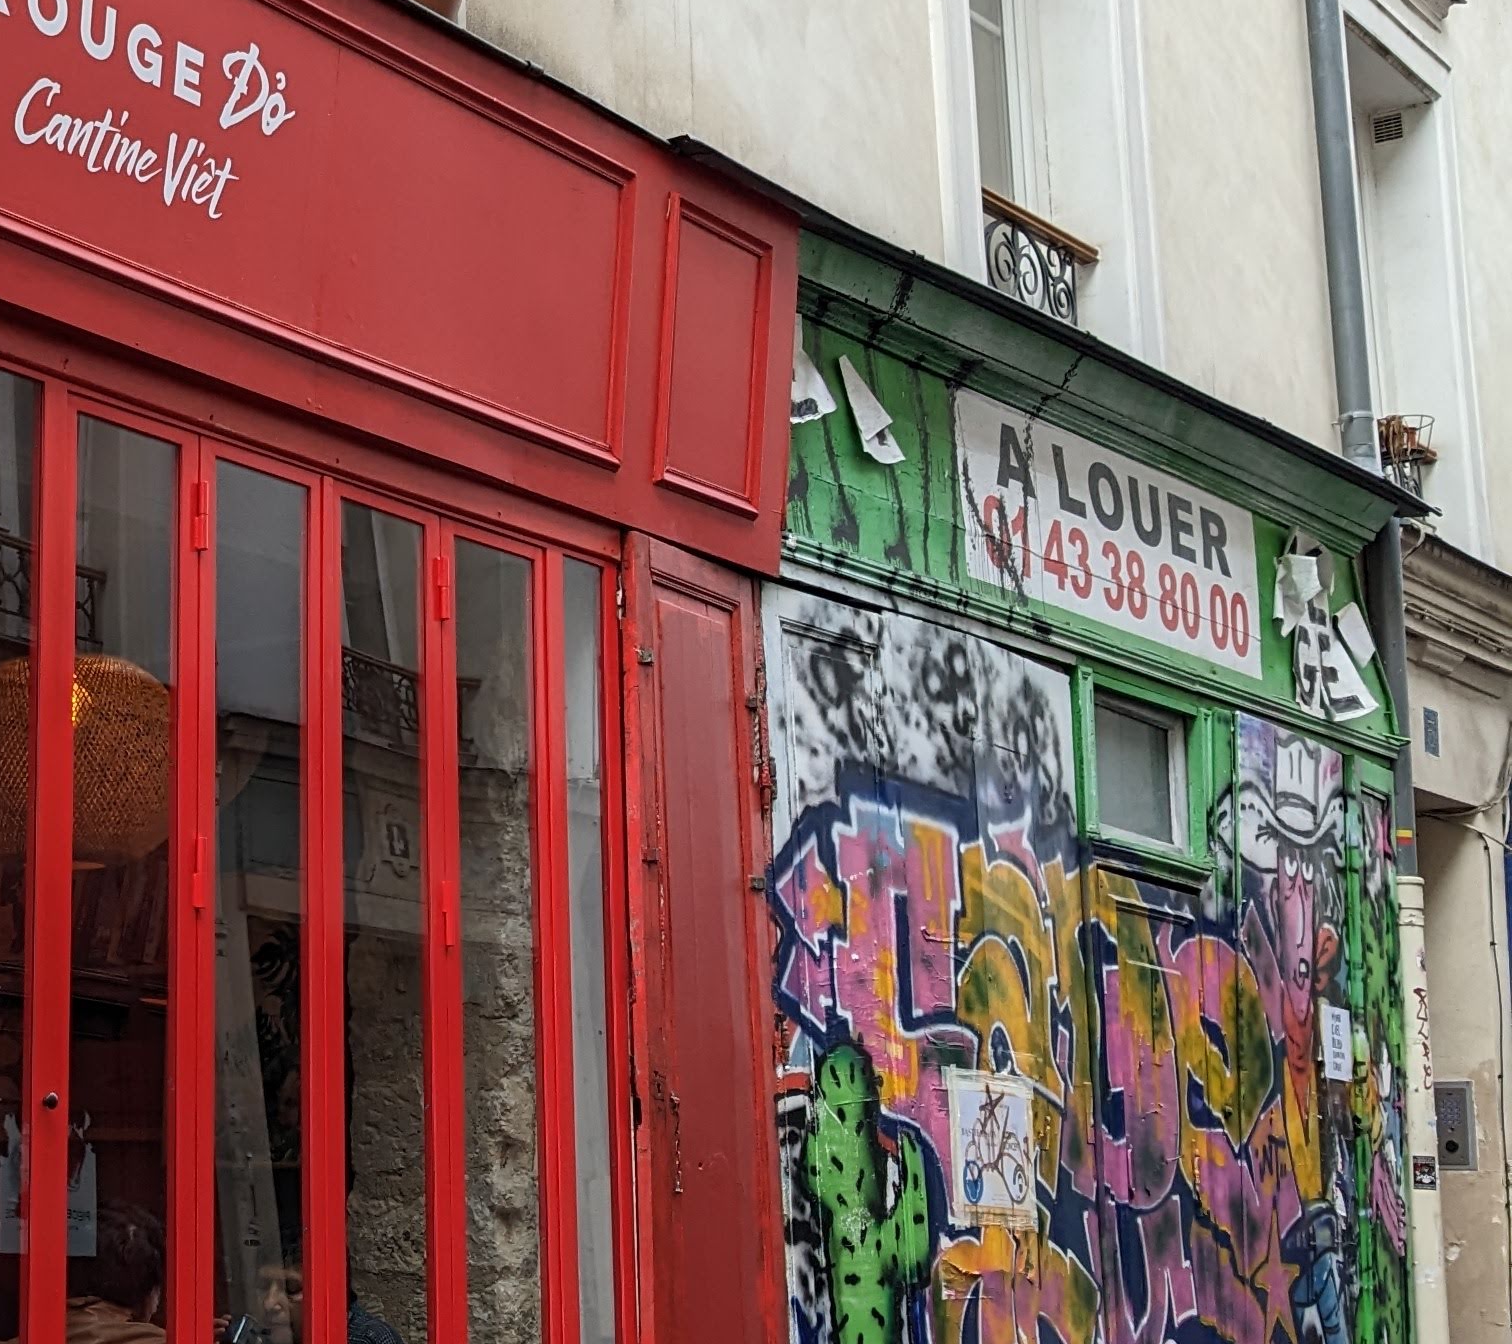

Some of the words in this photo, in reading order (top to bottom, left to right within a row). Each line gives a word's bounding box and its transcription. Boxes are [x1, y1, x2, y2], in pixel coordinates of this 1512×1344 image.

[13, 77, 163, 183] Cantine
[996, 422, 1037, 500] A
[1051, 443, 1233, 579] LOUER
[1043, 518, 1093, 600] 43
[1101, 540, 1148, 621] 38
[1158, 562, 1201, 640] 80
[1209, 583, 1250, 658] 00
